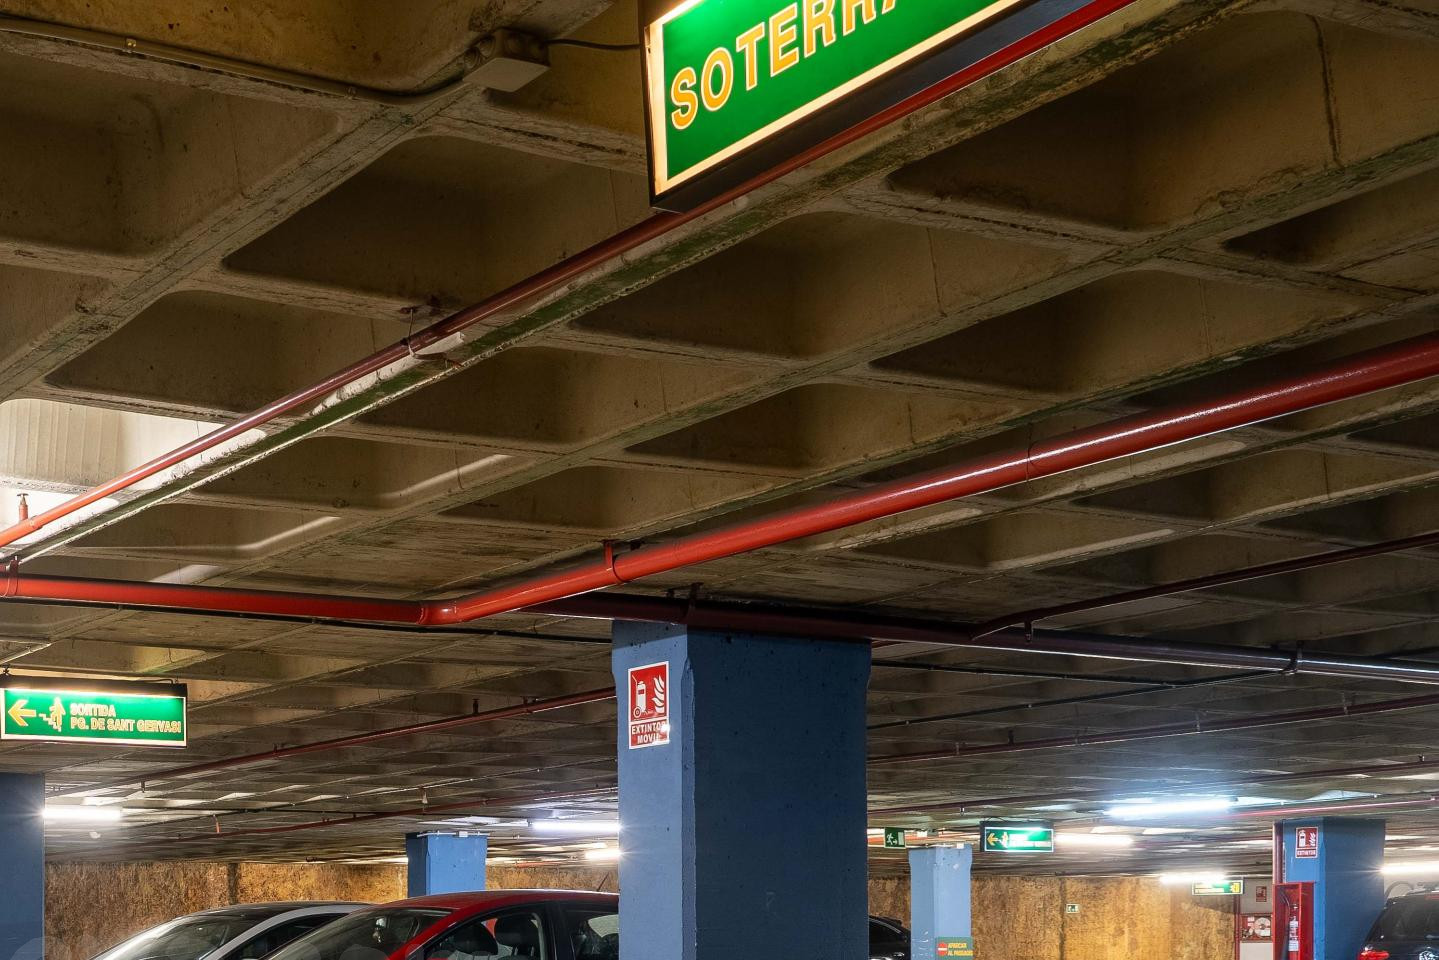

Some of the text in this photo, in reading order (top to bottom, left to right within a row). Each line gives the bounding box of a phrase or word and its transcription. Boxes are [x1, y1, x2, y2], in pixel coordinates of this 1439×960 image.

[69, 702, 117, 717] SORTIDA
[70, 716, 182, 734] PG. DE SANT GERVASI
